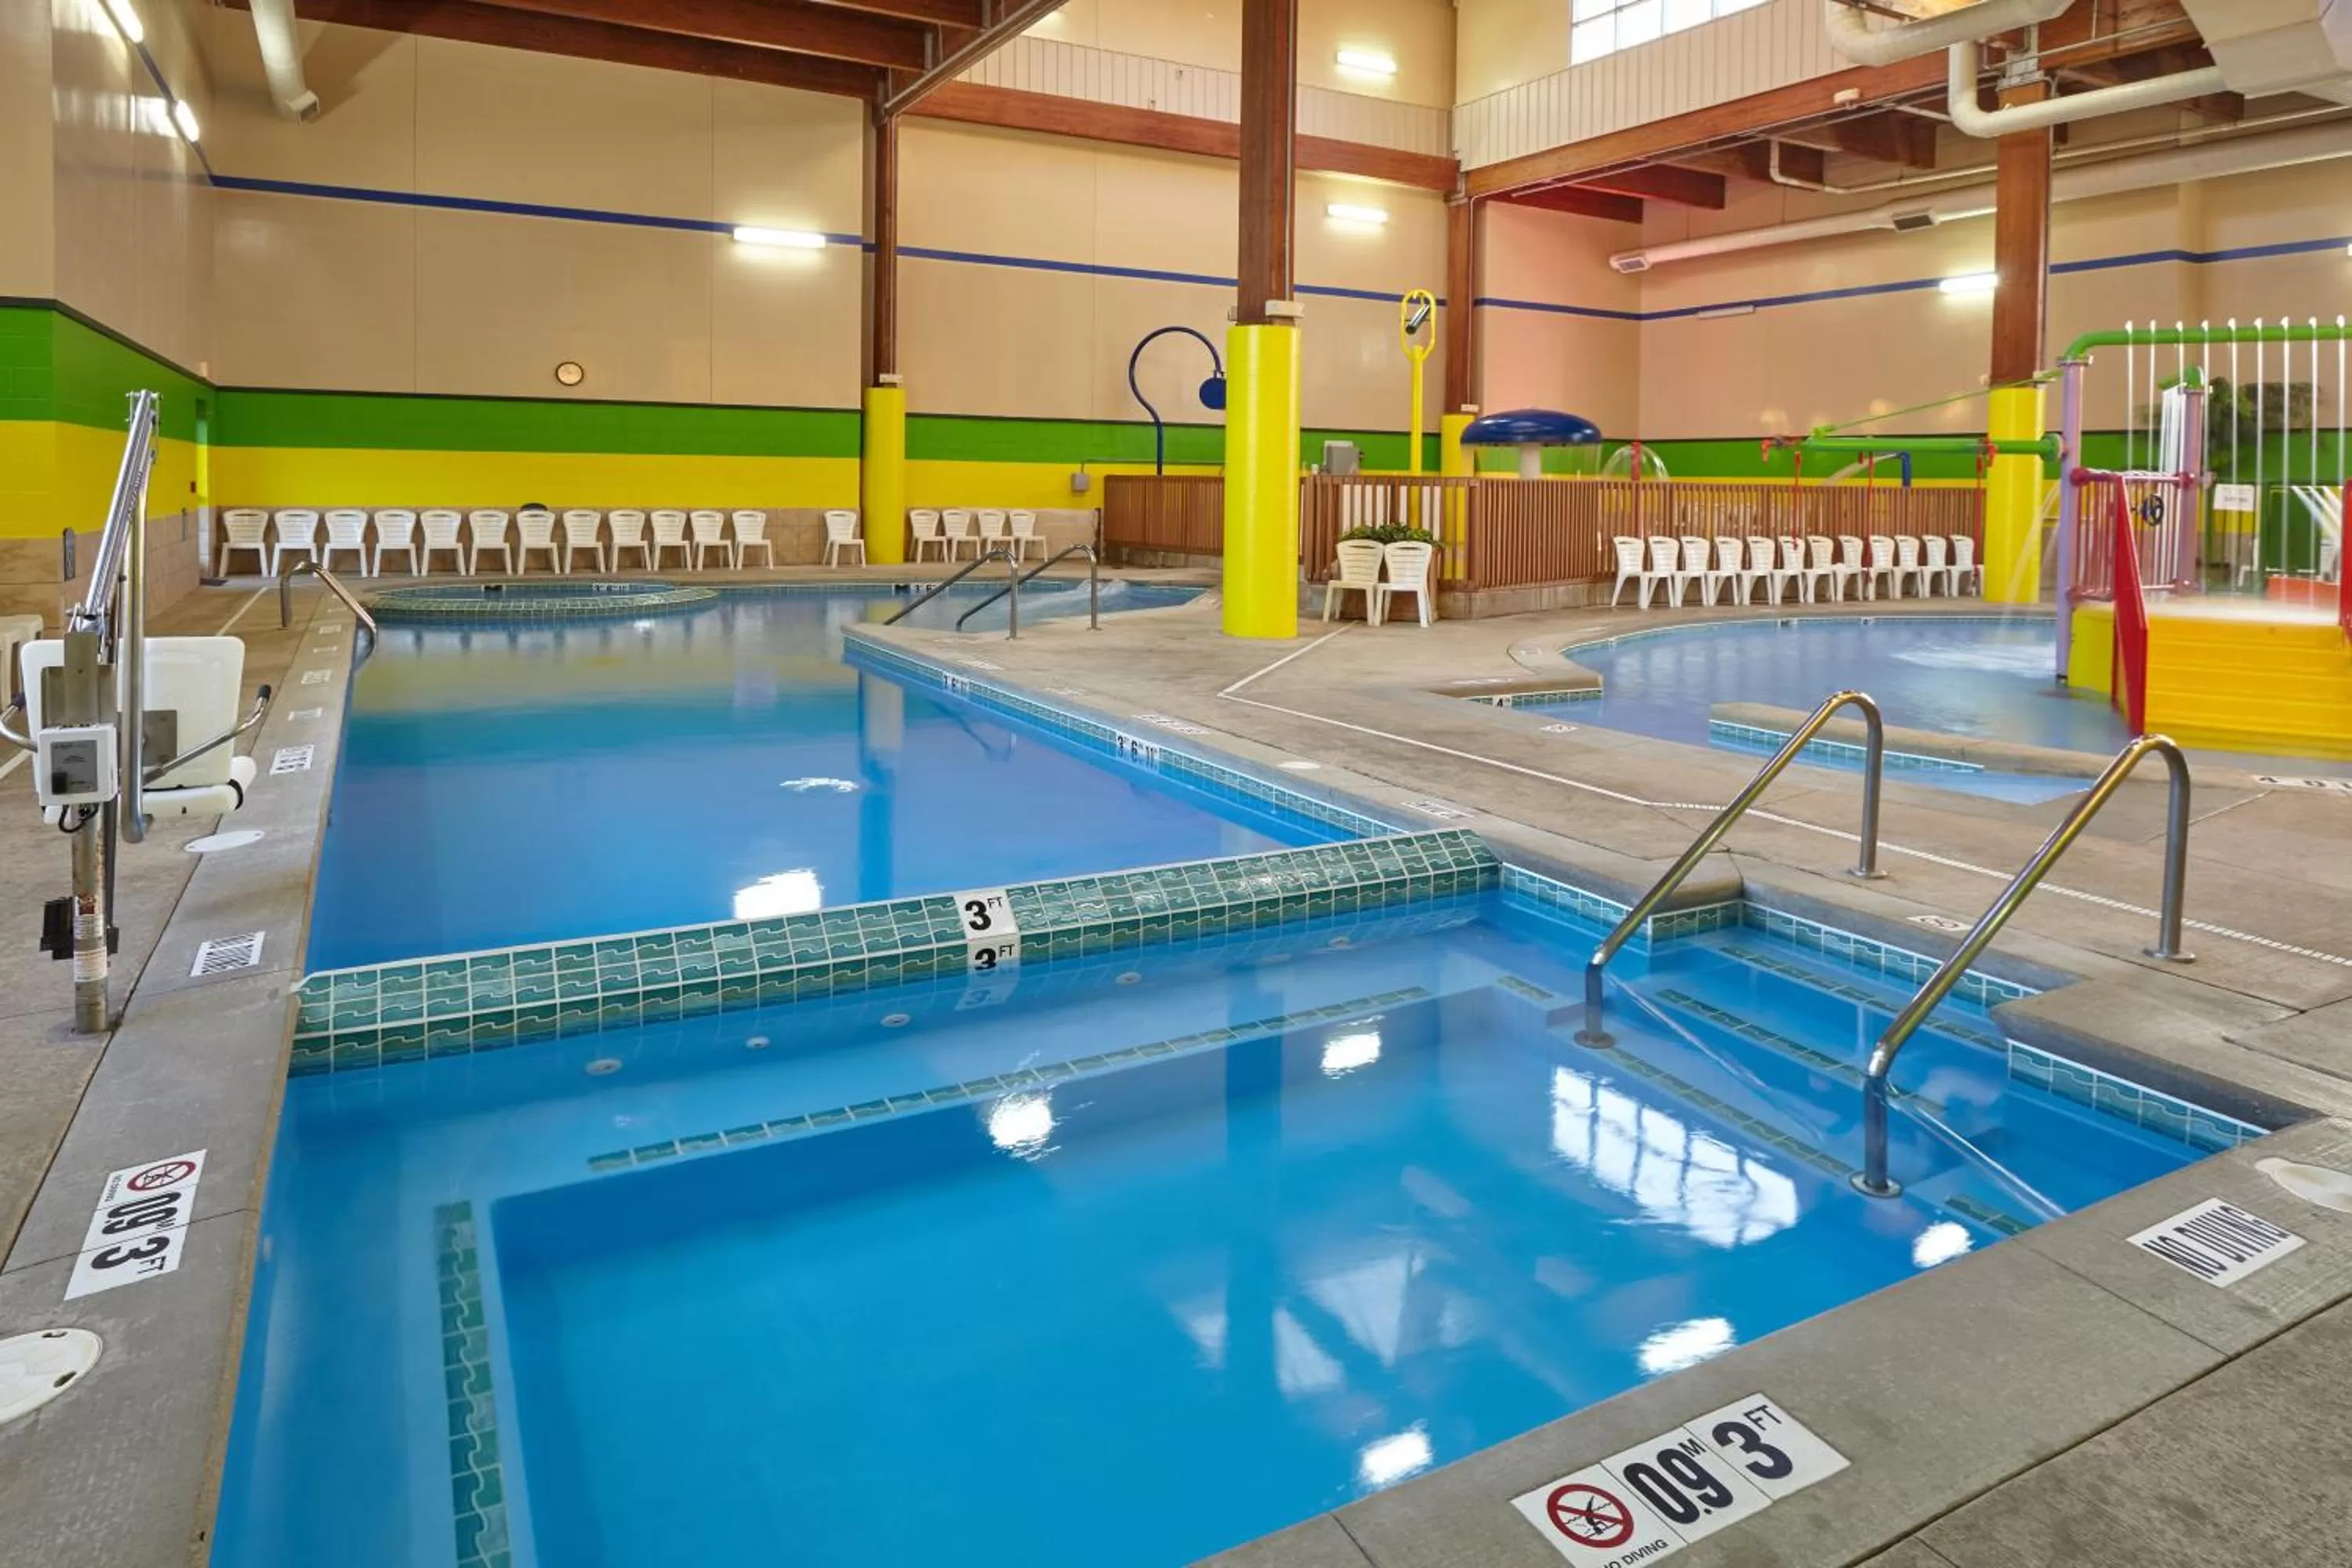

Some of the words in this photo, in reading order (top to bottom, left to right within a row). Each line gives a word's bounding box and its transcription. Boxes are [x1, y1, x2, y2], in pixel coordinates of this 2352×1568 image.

[1131, 739, 1138, 755] 6
[965, 900, 991, 931] 3
[987, 896, 1003, 909] FT
[975, 948, 996, 971] 3
[999, 943, 1014, 956] FT
[102, 1192, 182, 1235] 0.9
[2173, 1205, 2292, 1263] DIVING
[91, 1236, 170, 1269] 3
[137, 1256, 166, 1275] FT
[2142, 1235, 2228, 1279] NO
[1744, 1404, 1782, 1432] FT
[1712, 1421, 1794, 1479] 3
[1623, 1448, 1734, 1525] 0.9
[1686, 1438, 1707, 1458] M
[1621, 1539, 1669, 1566] DIVING
